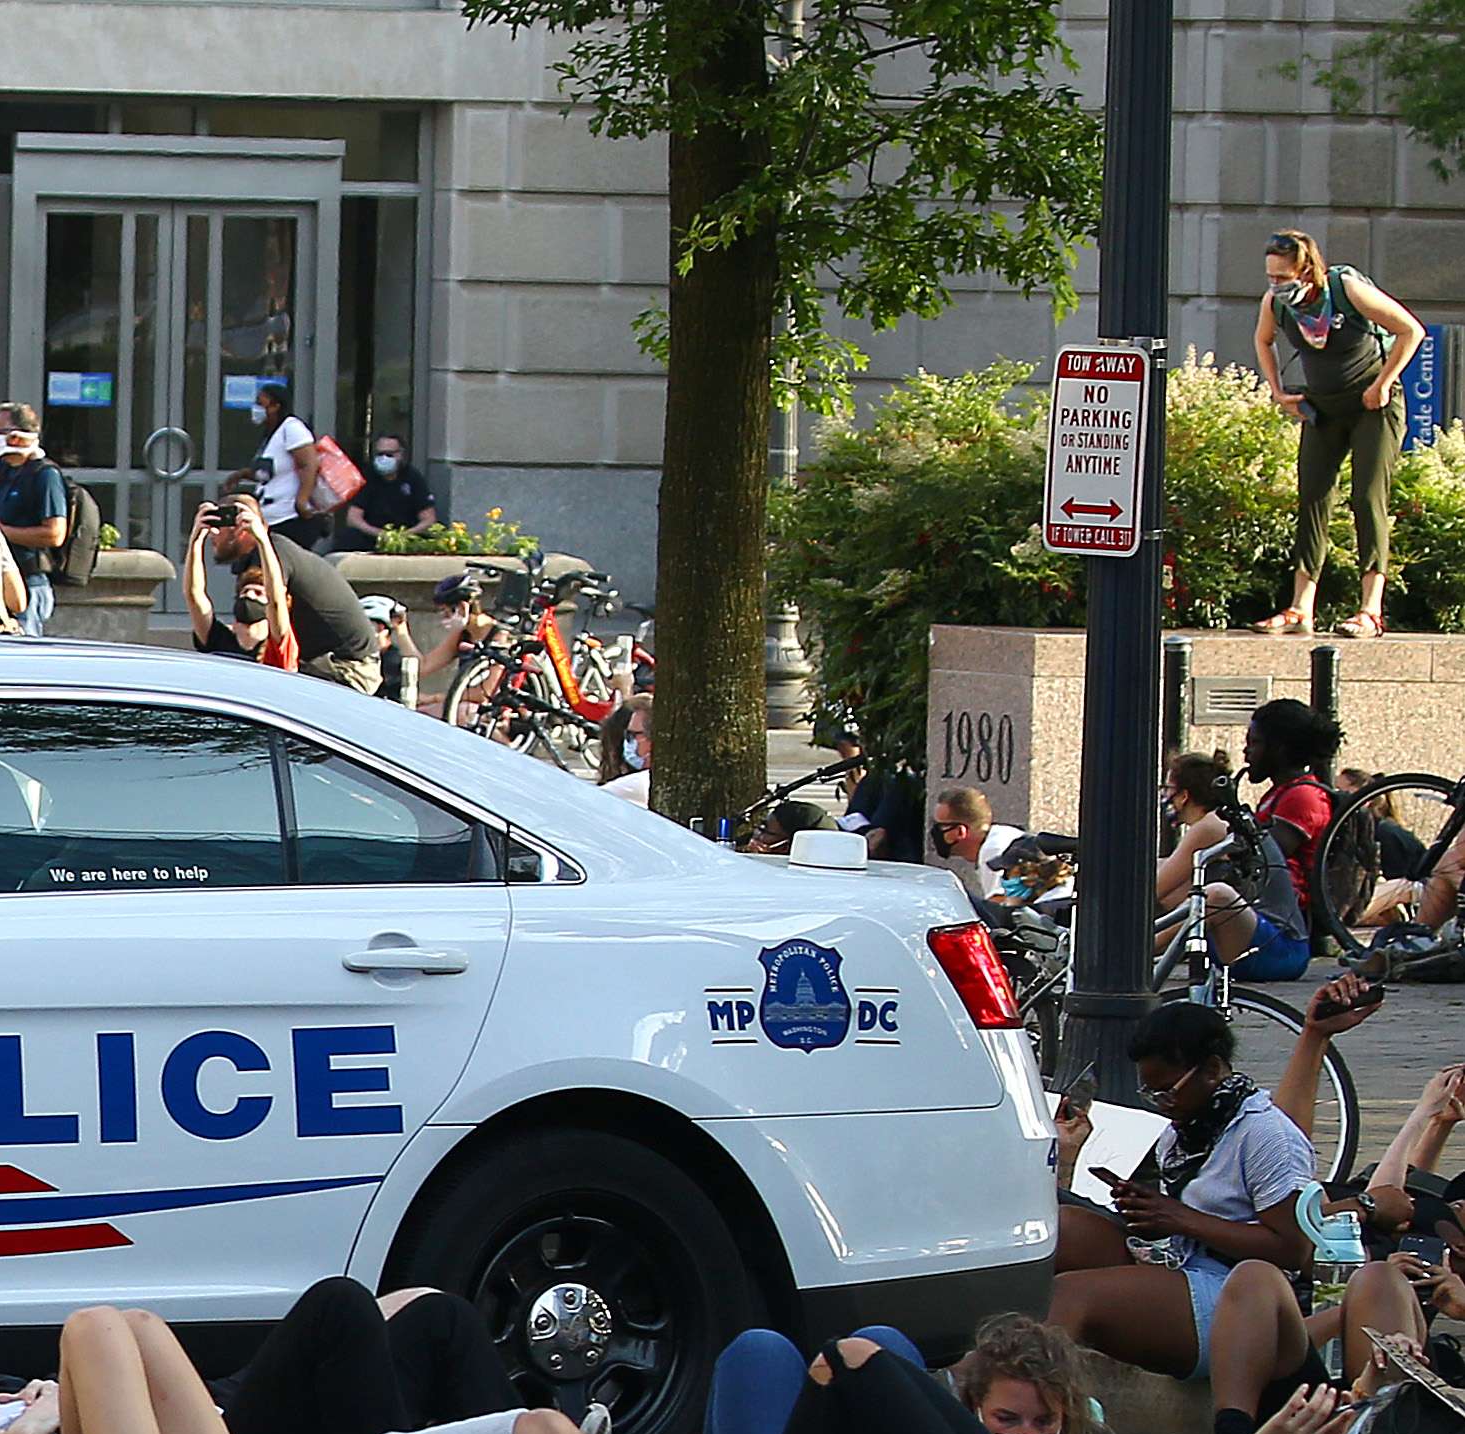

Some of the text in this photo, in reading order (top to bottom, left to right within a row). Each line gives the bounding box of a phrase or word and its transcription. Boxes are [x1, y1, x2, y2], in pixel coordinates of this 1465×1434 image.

[1067, 354, 1136, 374] TOW AWAY
[1083, 385, 1109, 404] NO
[1060, 408, 1132, 430] PARKING
[1061, 432, 1130, 451] OR STANDING
[1065, 454, 1121, 476] ANYTIME
[1051, 526, 1133, 547] IF TOWED CALL 311
[941, 709, 1014, 785] 1980
[49, 865, 209, 882] We are here to help
[769, 945, 817, 993] METROPOLITAN
[819, 955, 840, 993] POLICE
[707, 1000, 756, 1032] MP
[856, 1000, 900, 1033] DC
